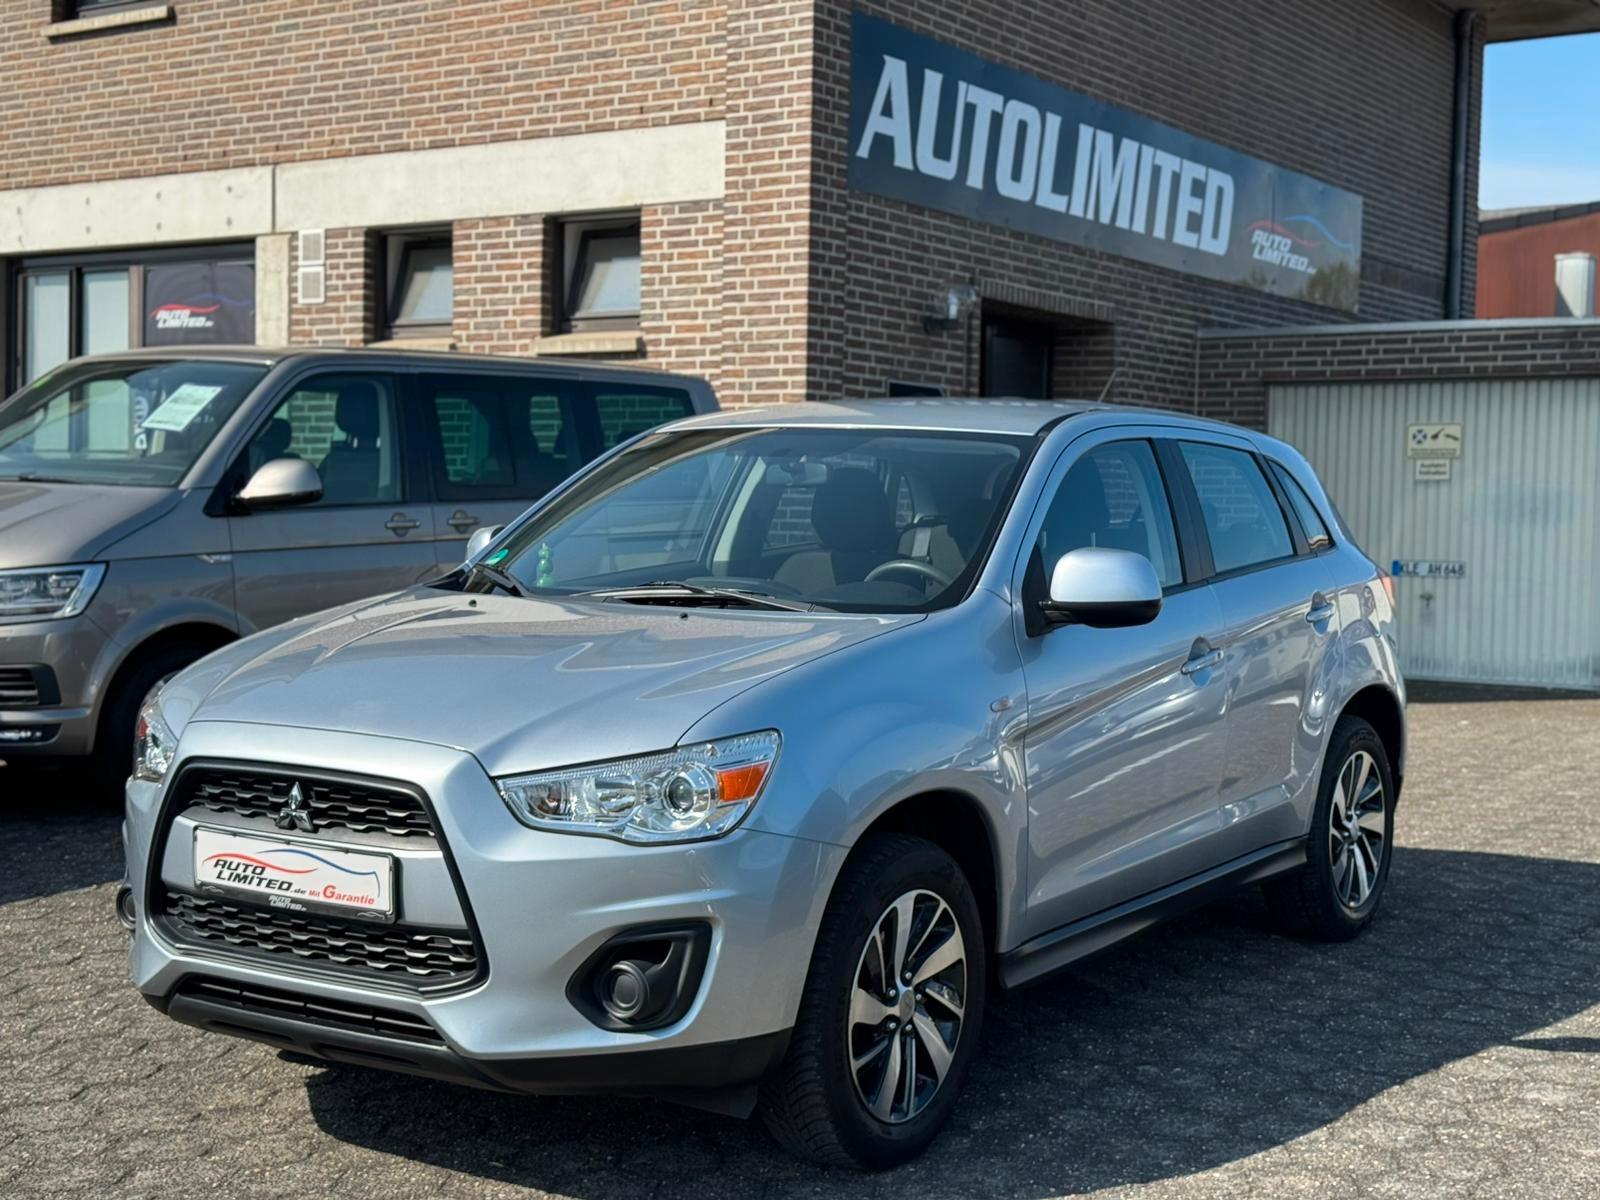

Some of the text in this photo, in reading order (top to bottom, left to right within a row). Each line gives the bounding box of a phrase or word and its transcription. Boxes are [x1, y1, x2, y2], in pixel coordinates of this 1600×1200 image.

[855, 54, 1235, 256] AUTOLIMITED
[1251, 229, 1292, 253] AUTO
[157, 317, 215, 329] LIMITED.
[213, 859, 267, 876] AUTO
[308, 889, 321, 898] Mit
[323, 885, 376, 905] Garantie
[270, 901, 307, 912] LIMITED.
